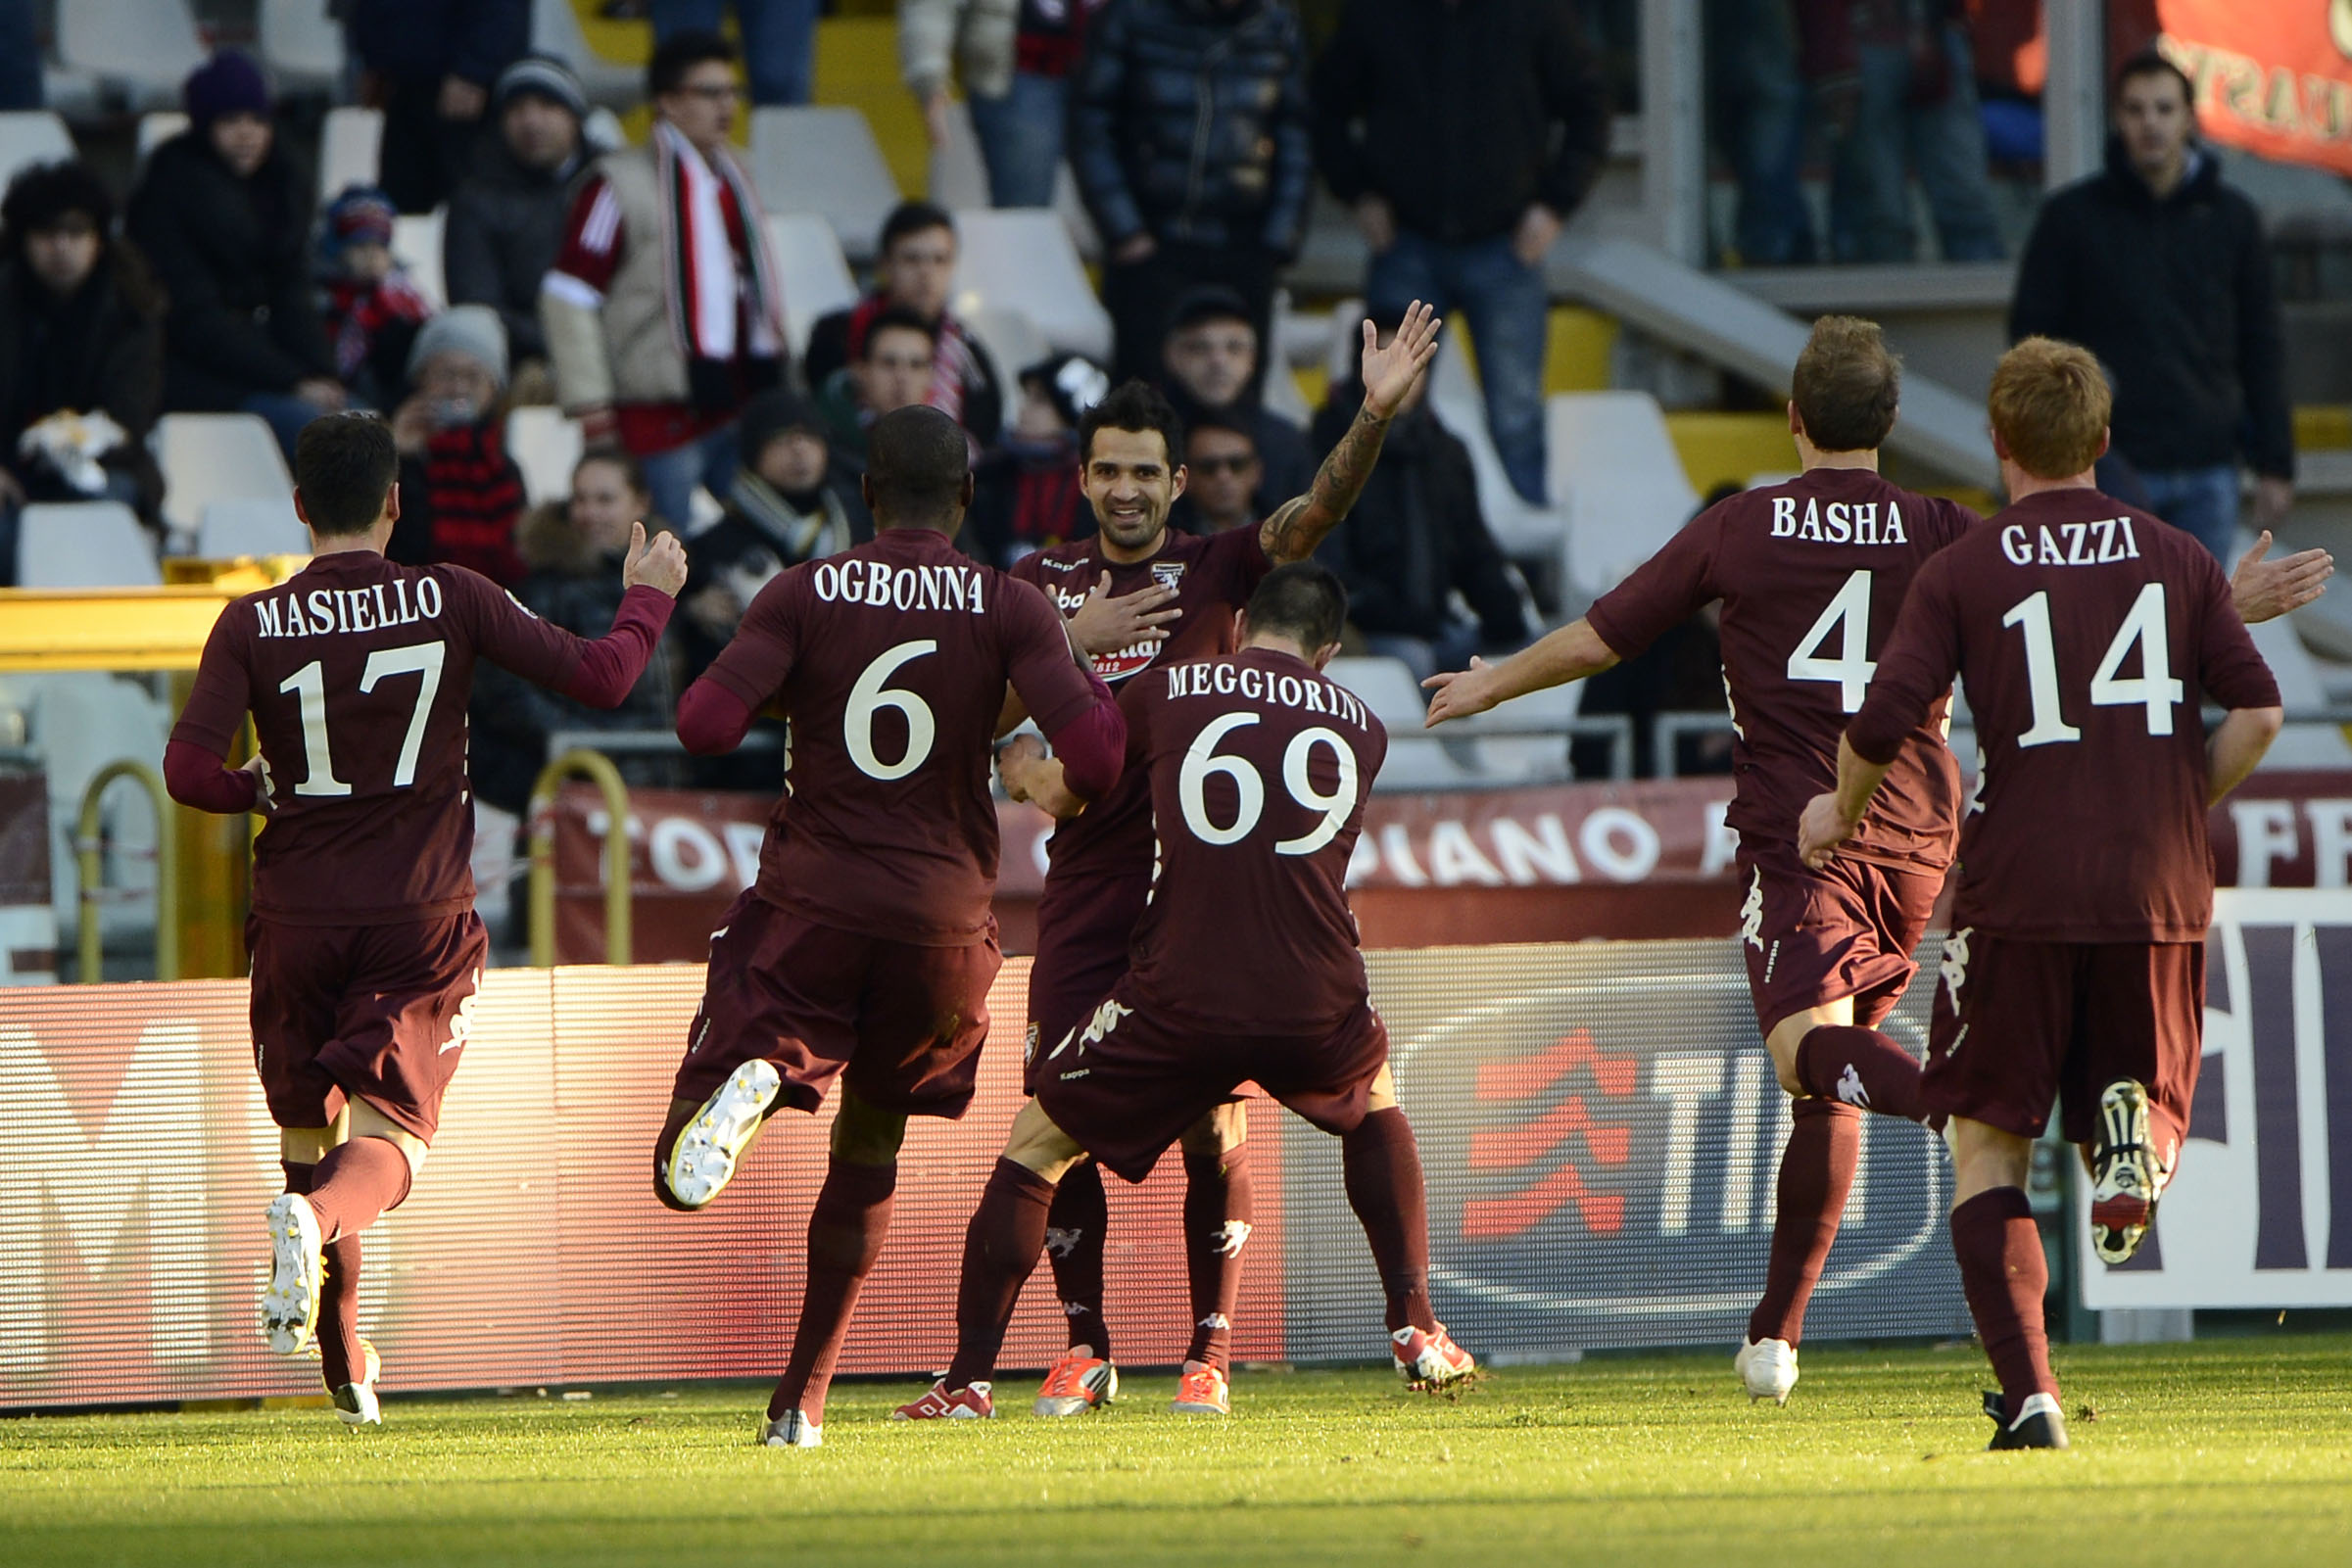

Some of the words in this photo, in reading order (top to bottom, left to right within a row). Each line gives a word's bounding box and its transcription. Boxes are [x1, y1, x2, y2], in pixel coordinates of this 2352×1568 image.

[1770, 497, 1908, 545] BASHA
[2001, 516, 2140, 566] GAZZI
[254, 576, 443, 639] MASIELLO
[813, 558, 984, 614] OGBONNA
[1788, 570, 1878, 713] 4
[2003, 583, 2184, 748] 14
[279, 641, 446, 797] 17
[843, 640, 937, 781] 6
[1167, 663, 1368, 732] MEGGIORINI
[1178, 711, 1359, 855] 69
